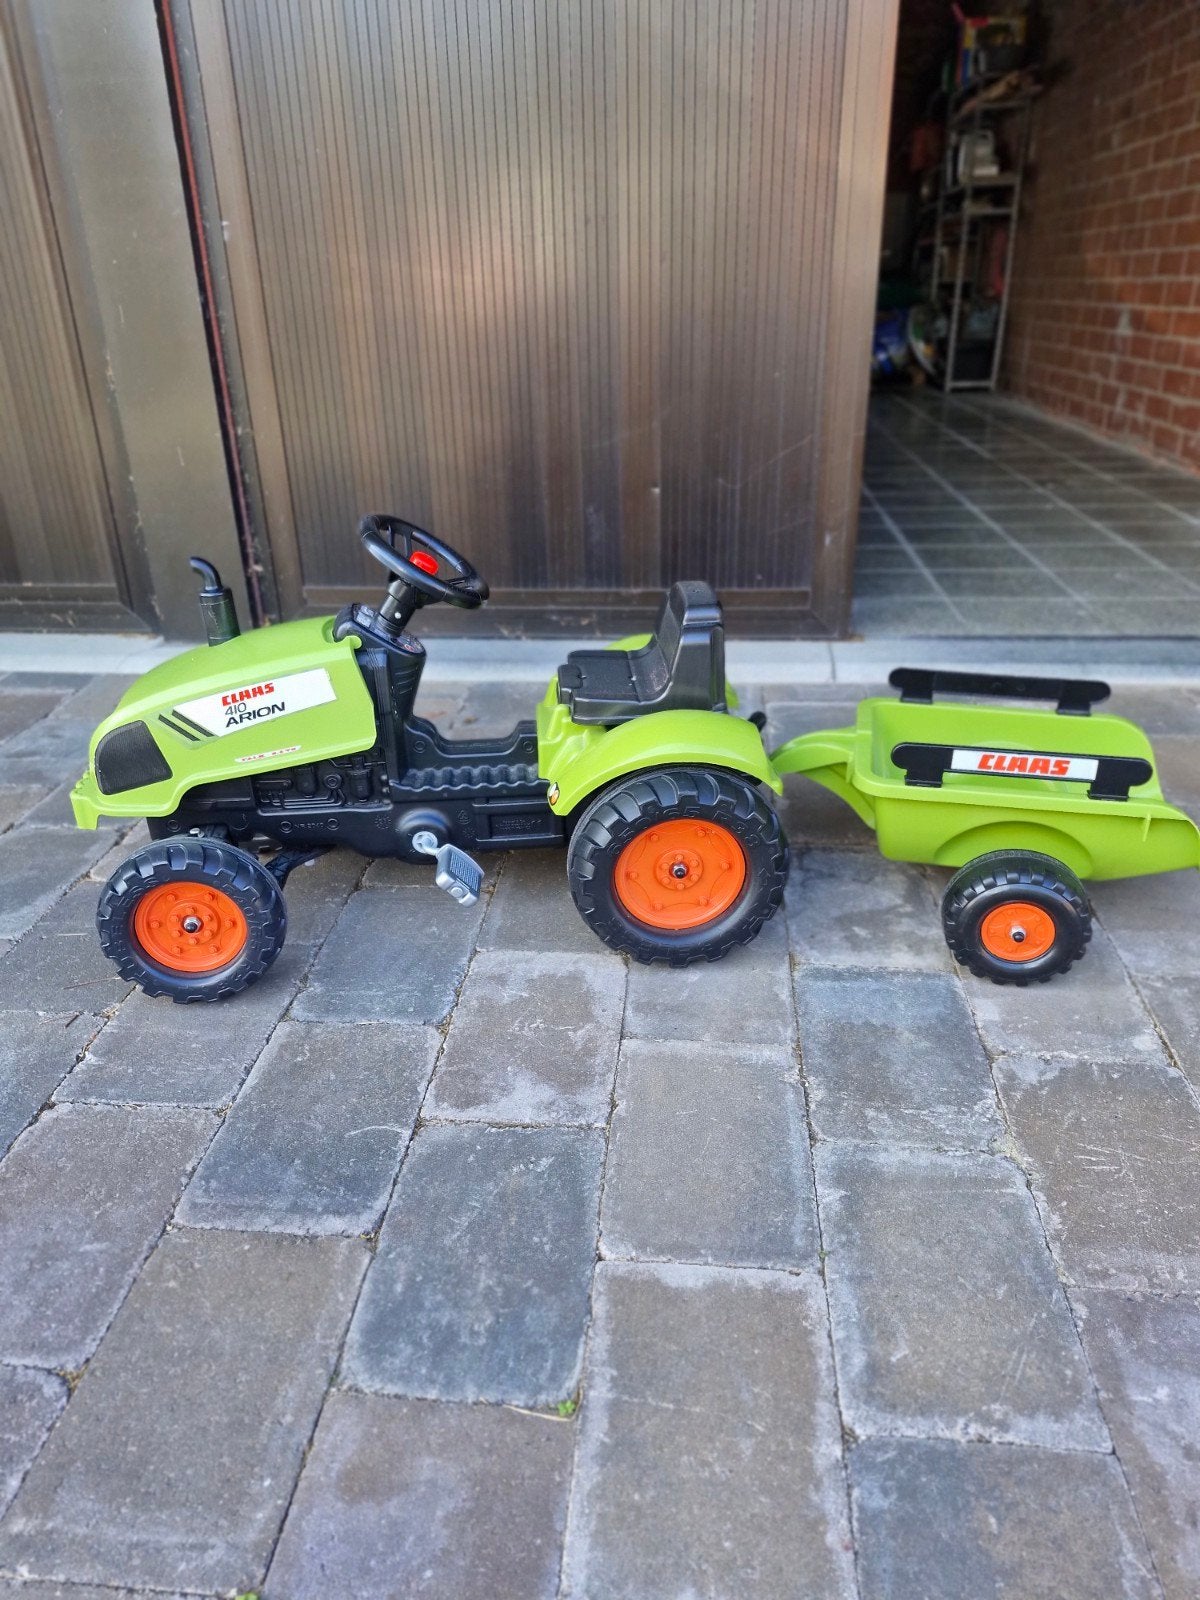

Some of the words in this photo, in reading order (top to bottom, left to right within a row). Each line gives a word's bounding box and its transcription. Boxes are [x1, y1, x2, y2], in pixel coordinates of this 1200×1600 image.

[221, 682, 275, 707] CLAAS
[225, 702, 247, 716] 410
[225, 701, 286, 728] ARION
[977, 754, 1071, 776] CLAAS
